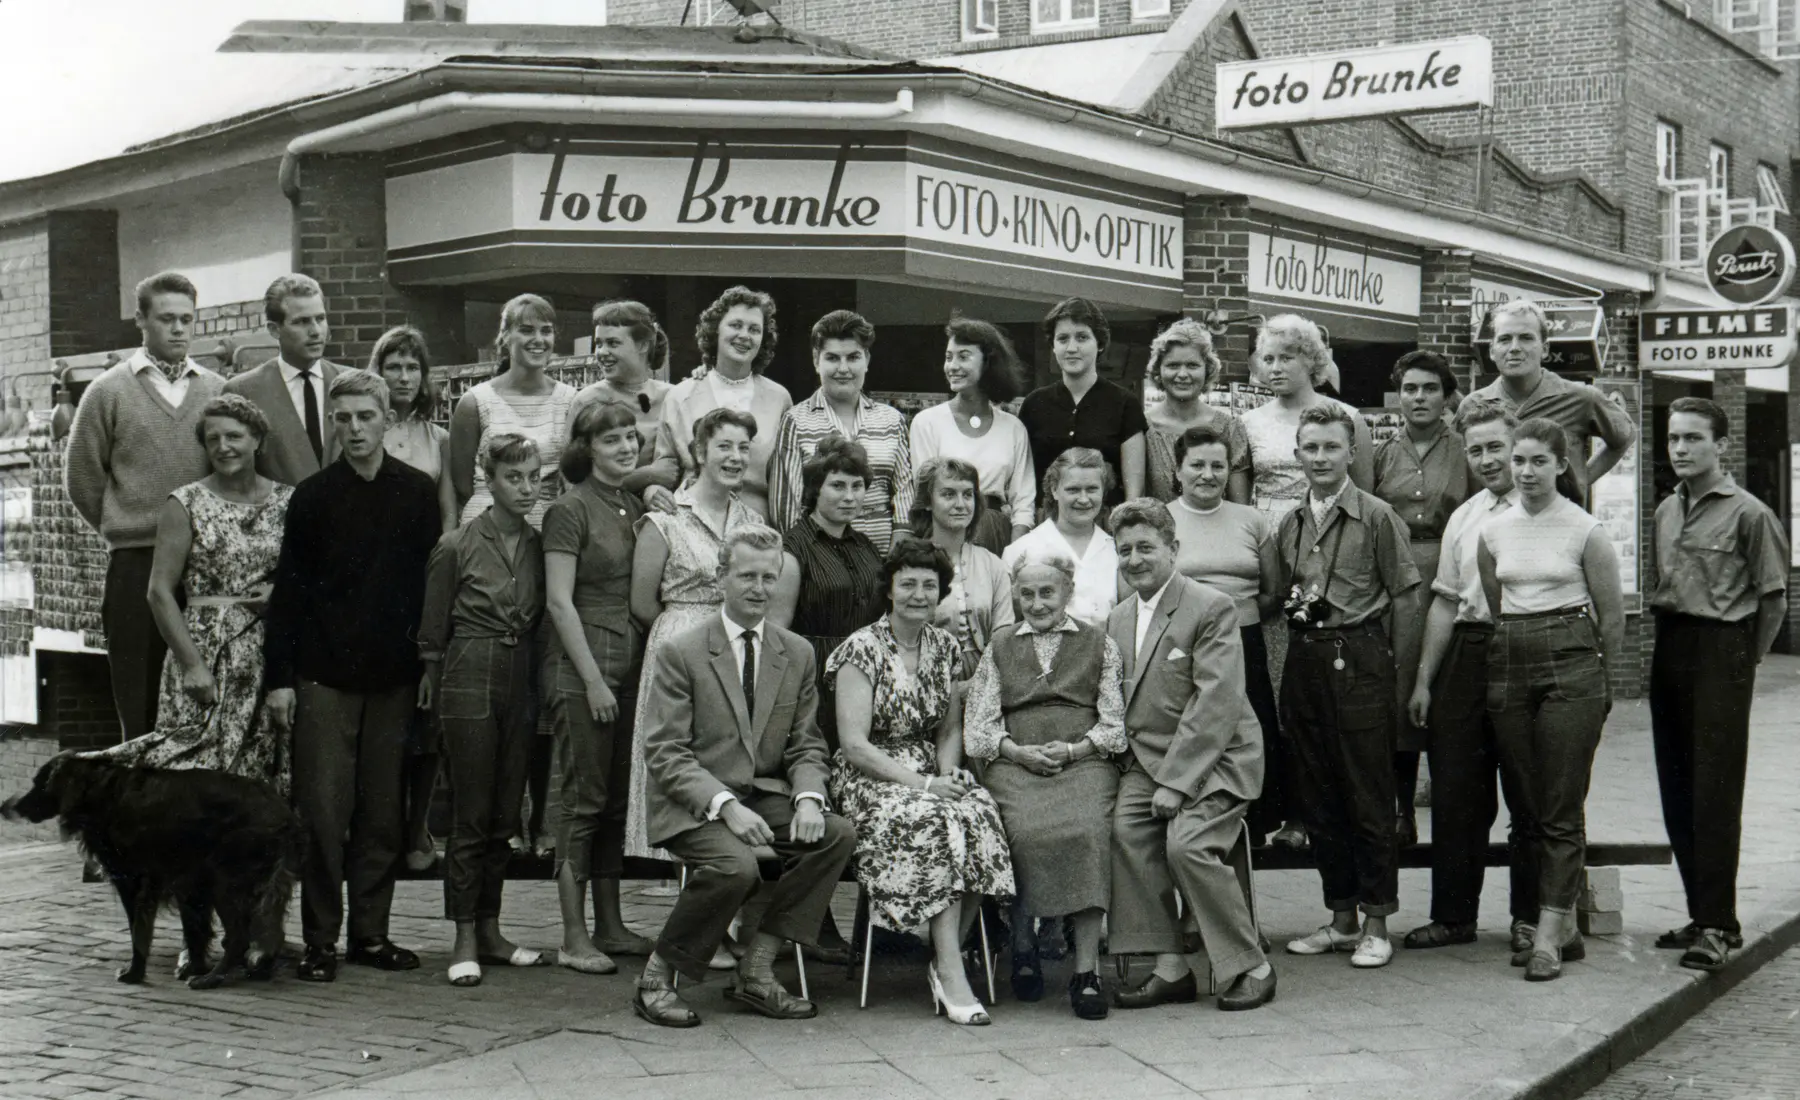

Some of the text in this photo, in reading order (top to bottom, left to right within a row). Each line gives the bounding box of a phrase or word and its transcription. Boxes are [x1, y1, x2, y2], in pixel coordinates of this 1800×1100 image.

[1232, 50, 1462, 110] foto Brunke
[539, 131, 881, 228] foto Brunke
[916, 174, 1176, 270] FOTO KINO OPTIK
[1265, 223, 1384, 306] foto Brunke
[1651, 344, 1773, 361] FOTO BRUNKE
[1655, 312, 1773, 335] FILME
